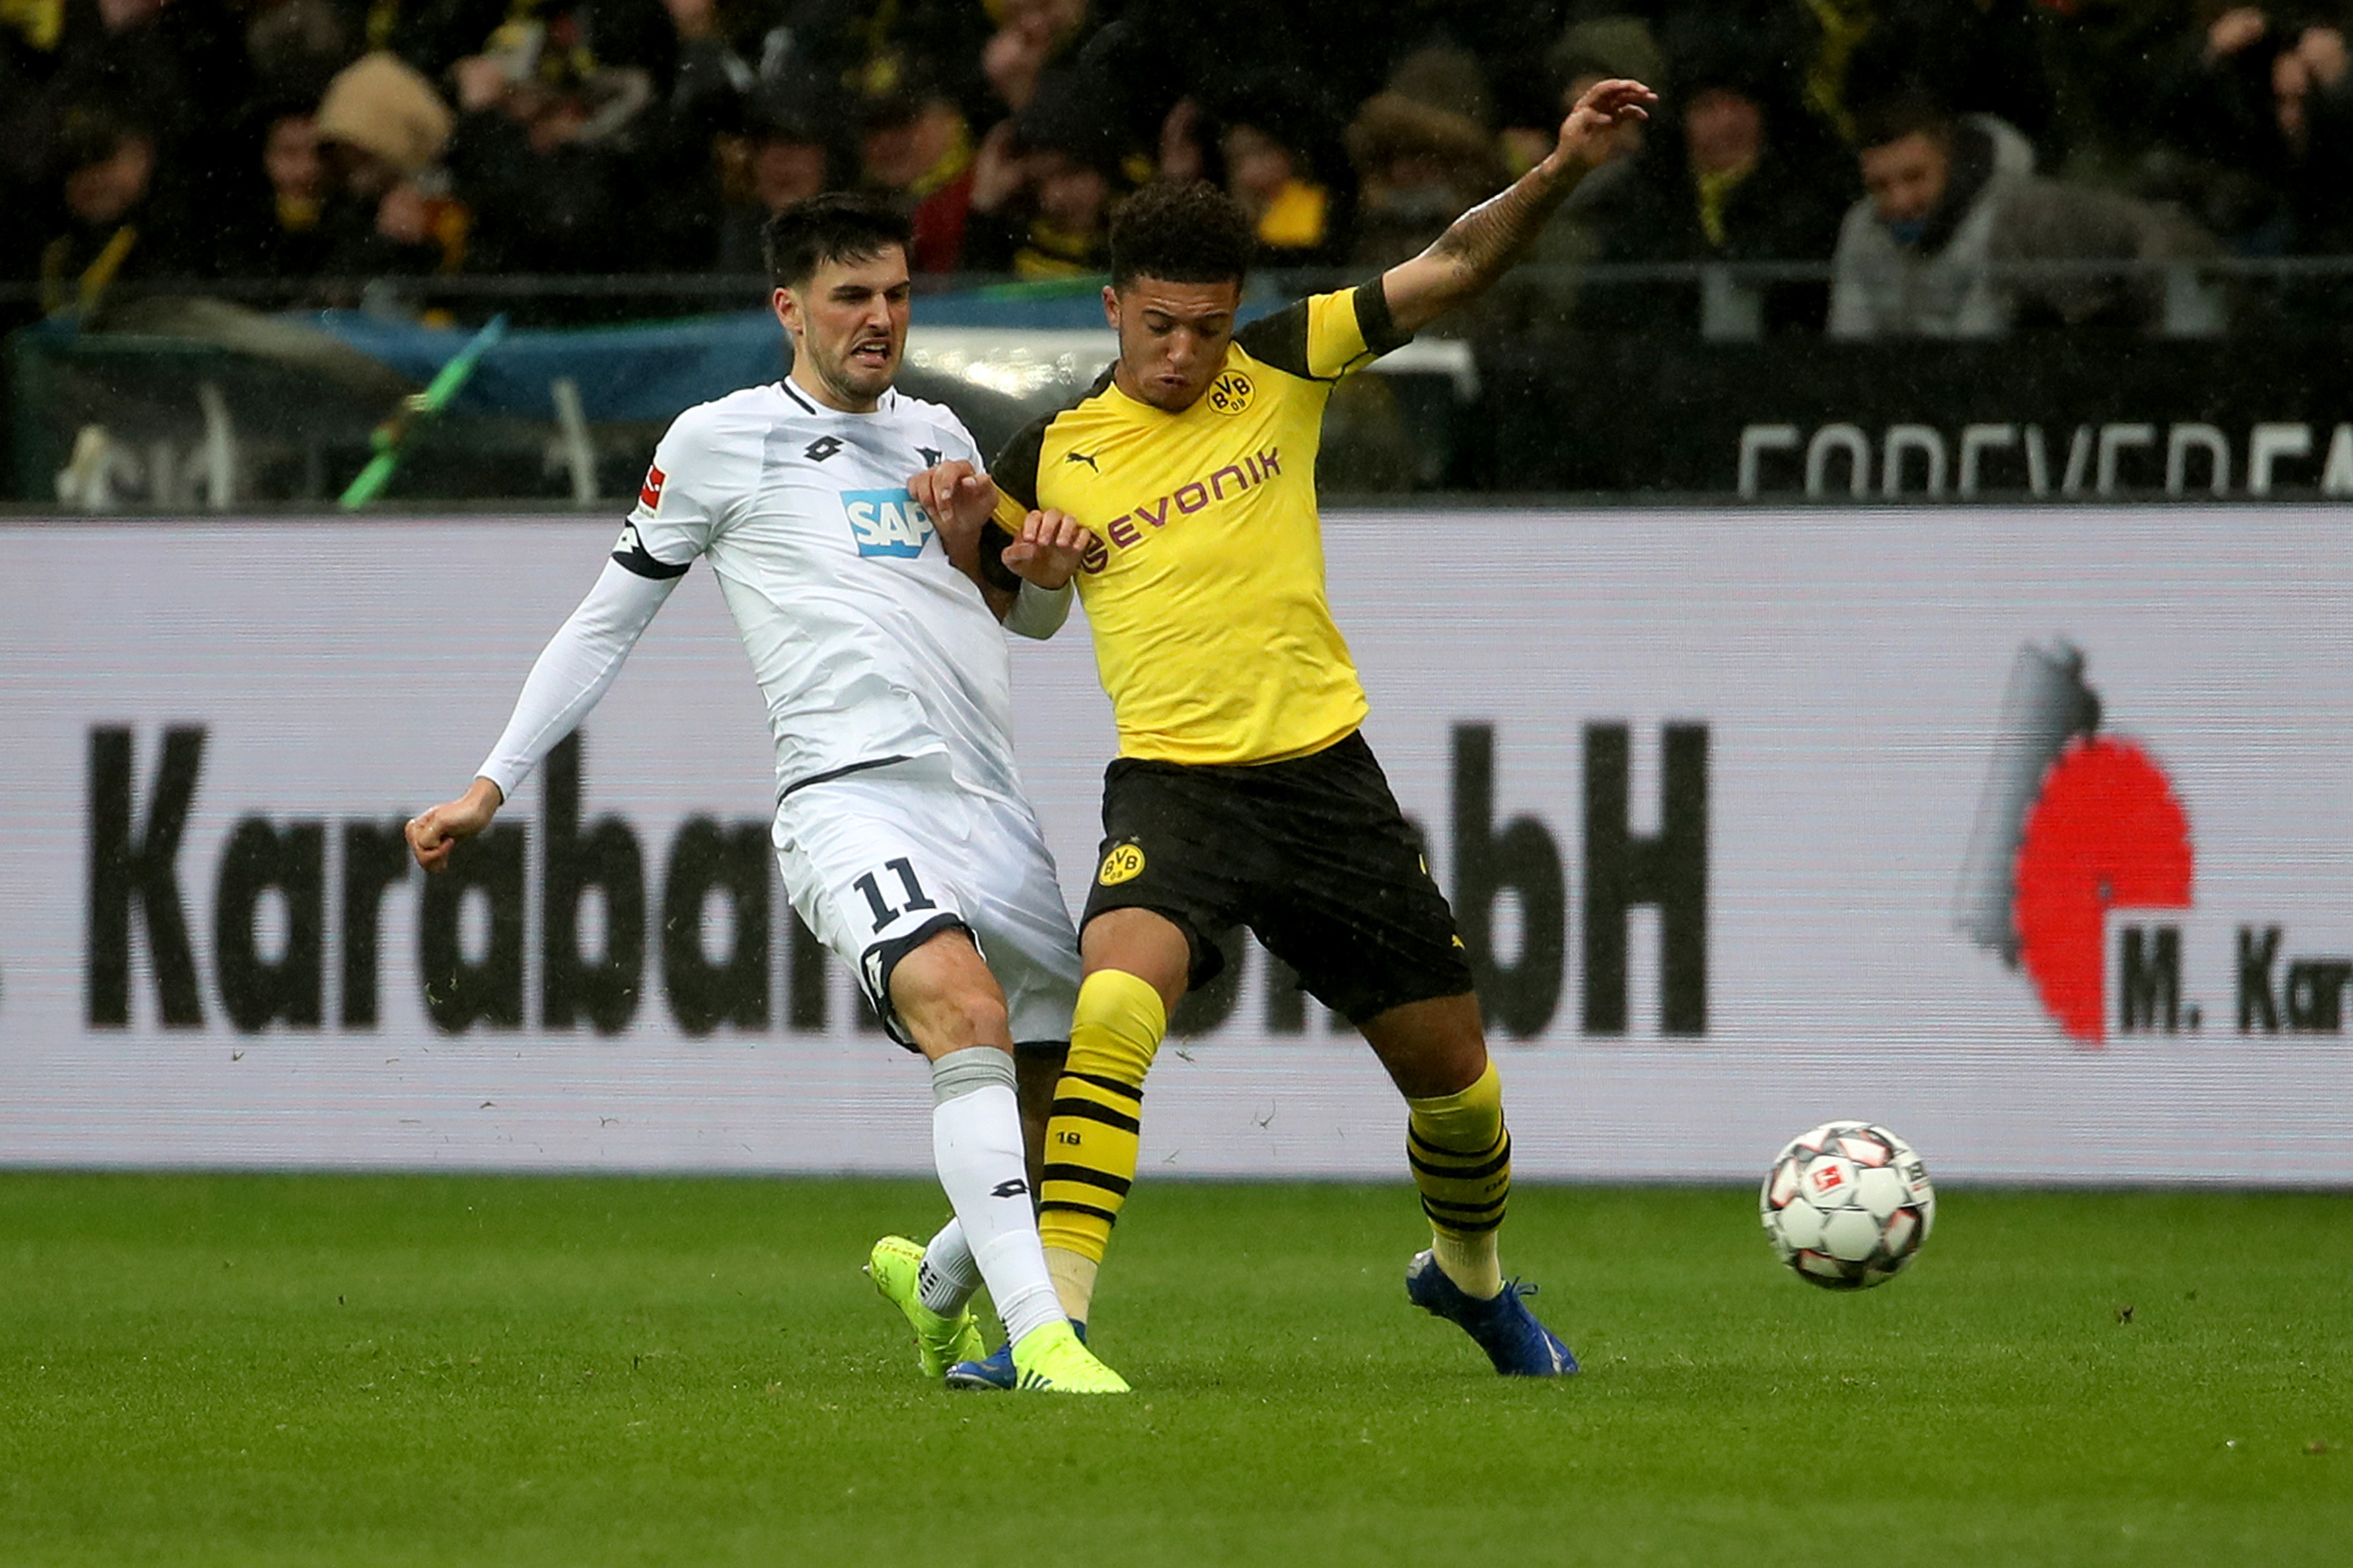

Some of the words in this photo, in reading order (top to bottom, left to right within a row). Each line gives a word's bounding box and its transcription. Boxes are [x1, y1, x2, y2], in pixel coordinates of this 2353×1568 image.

[1212, 374, 1250, 410] BVB
[847, 501, 933, 547] SAP
[1104, 848, 1138, 876] BVB
[852, 857, 937, 935] 11
[2120, 925, 2201, 1034] M.
